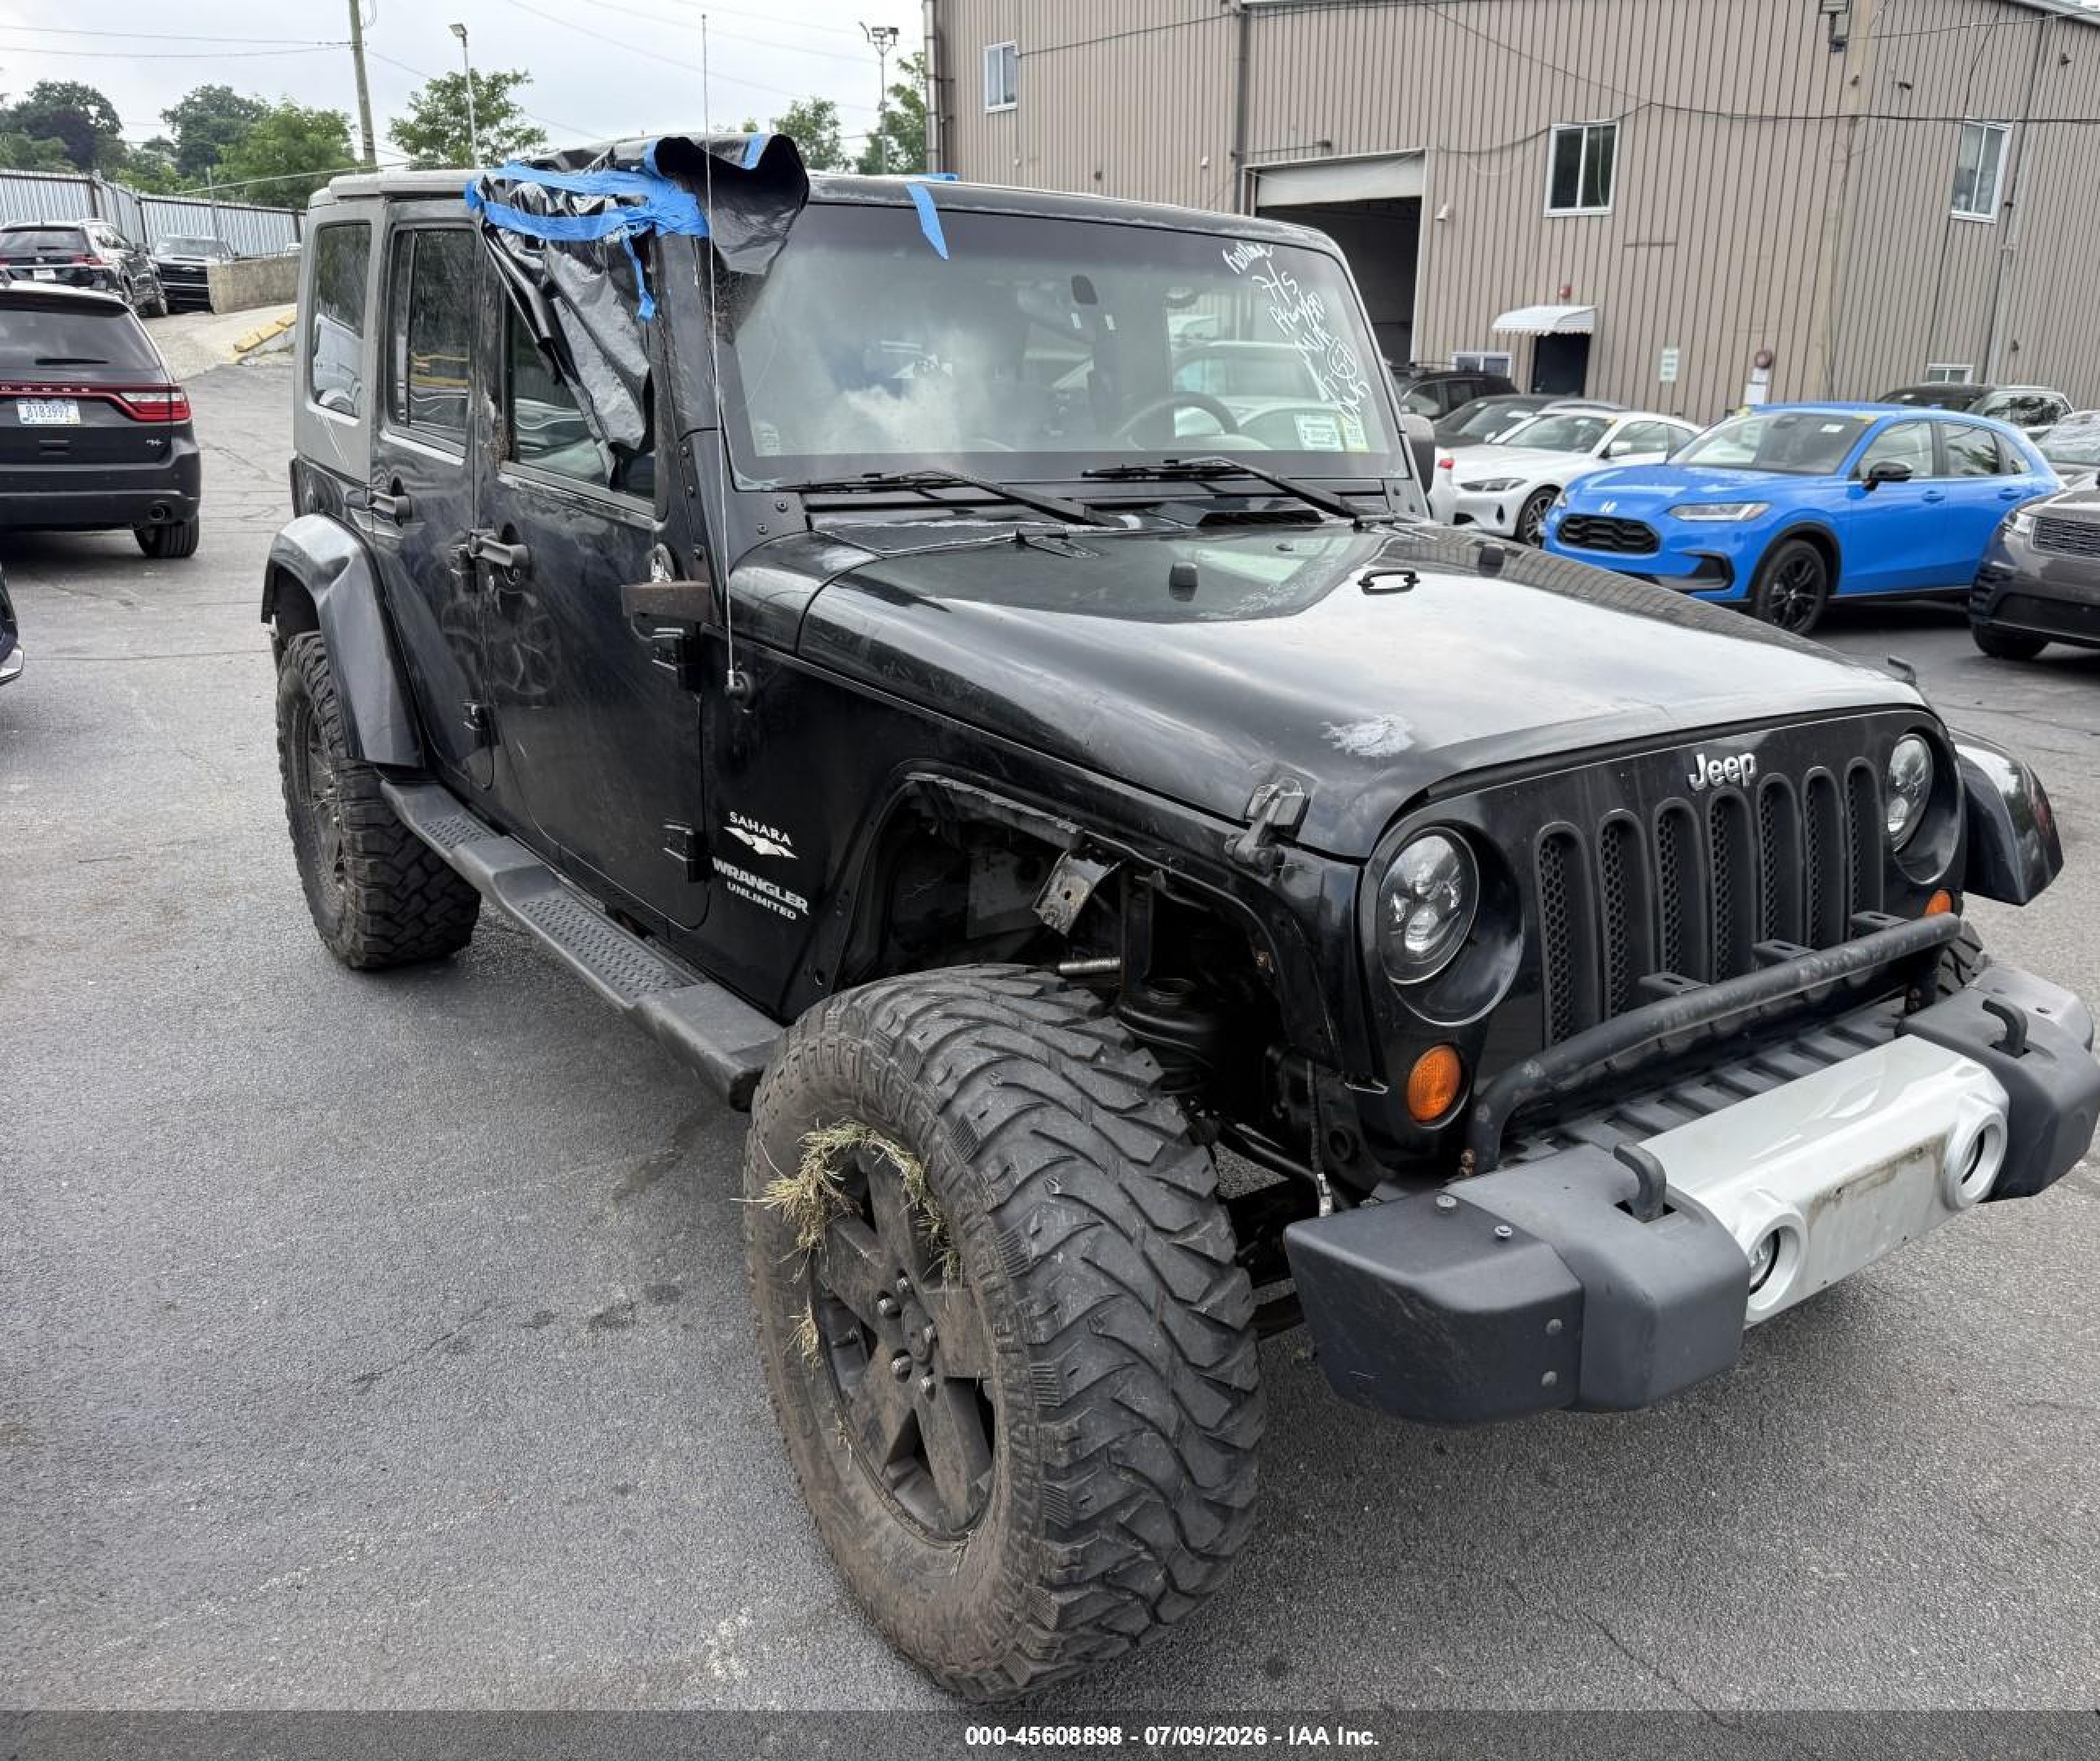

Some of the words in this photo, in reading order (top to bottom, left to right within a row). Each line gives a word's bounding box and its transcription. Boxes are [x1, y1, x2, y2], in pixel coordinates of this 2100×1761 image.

[1688, 753, 1758, 791] Jeep
[730, 811, 793, 847] SAHARA
[712, 856, 810, 916] WRANGLER
[726, 880, 796, 920] UNLIMITED
